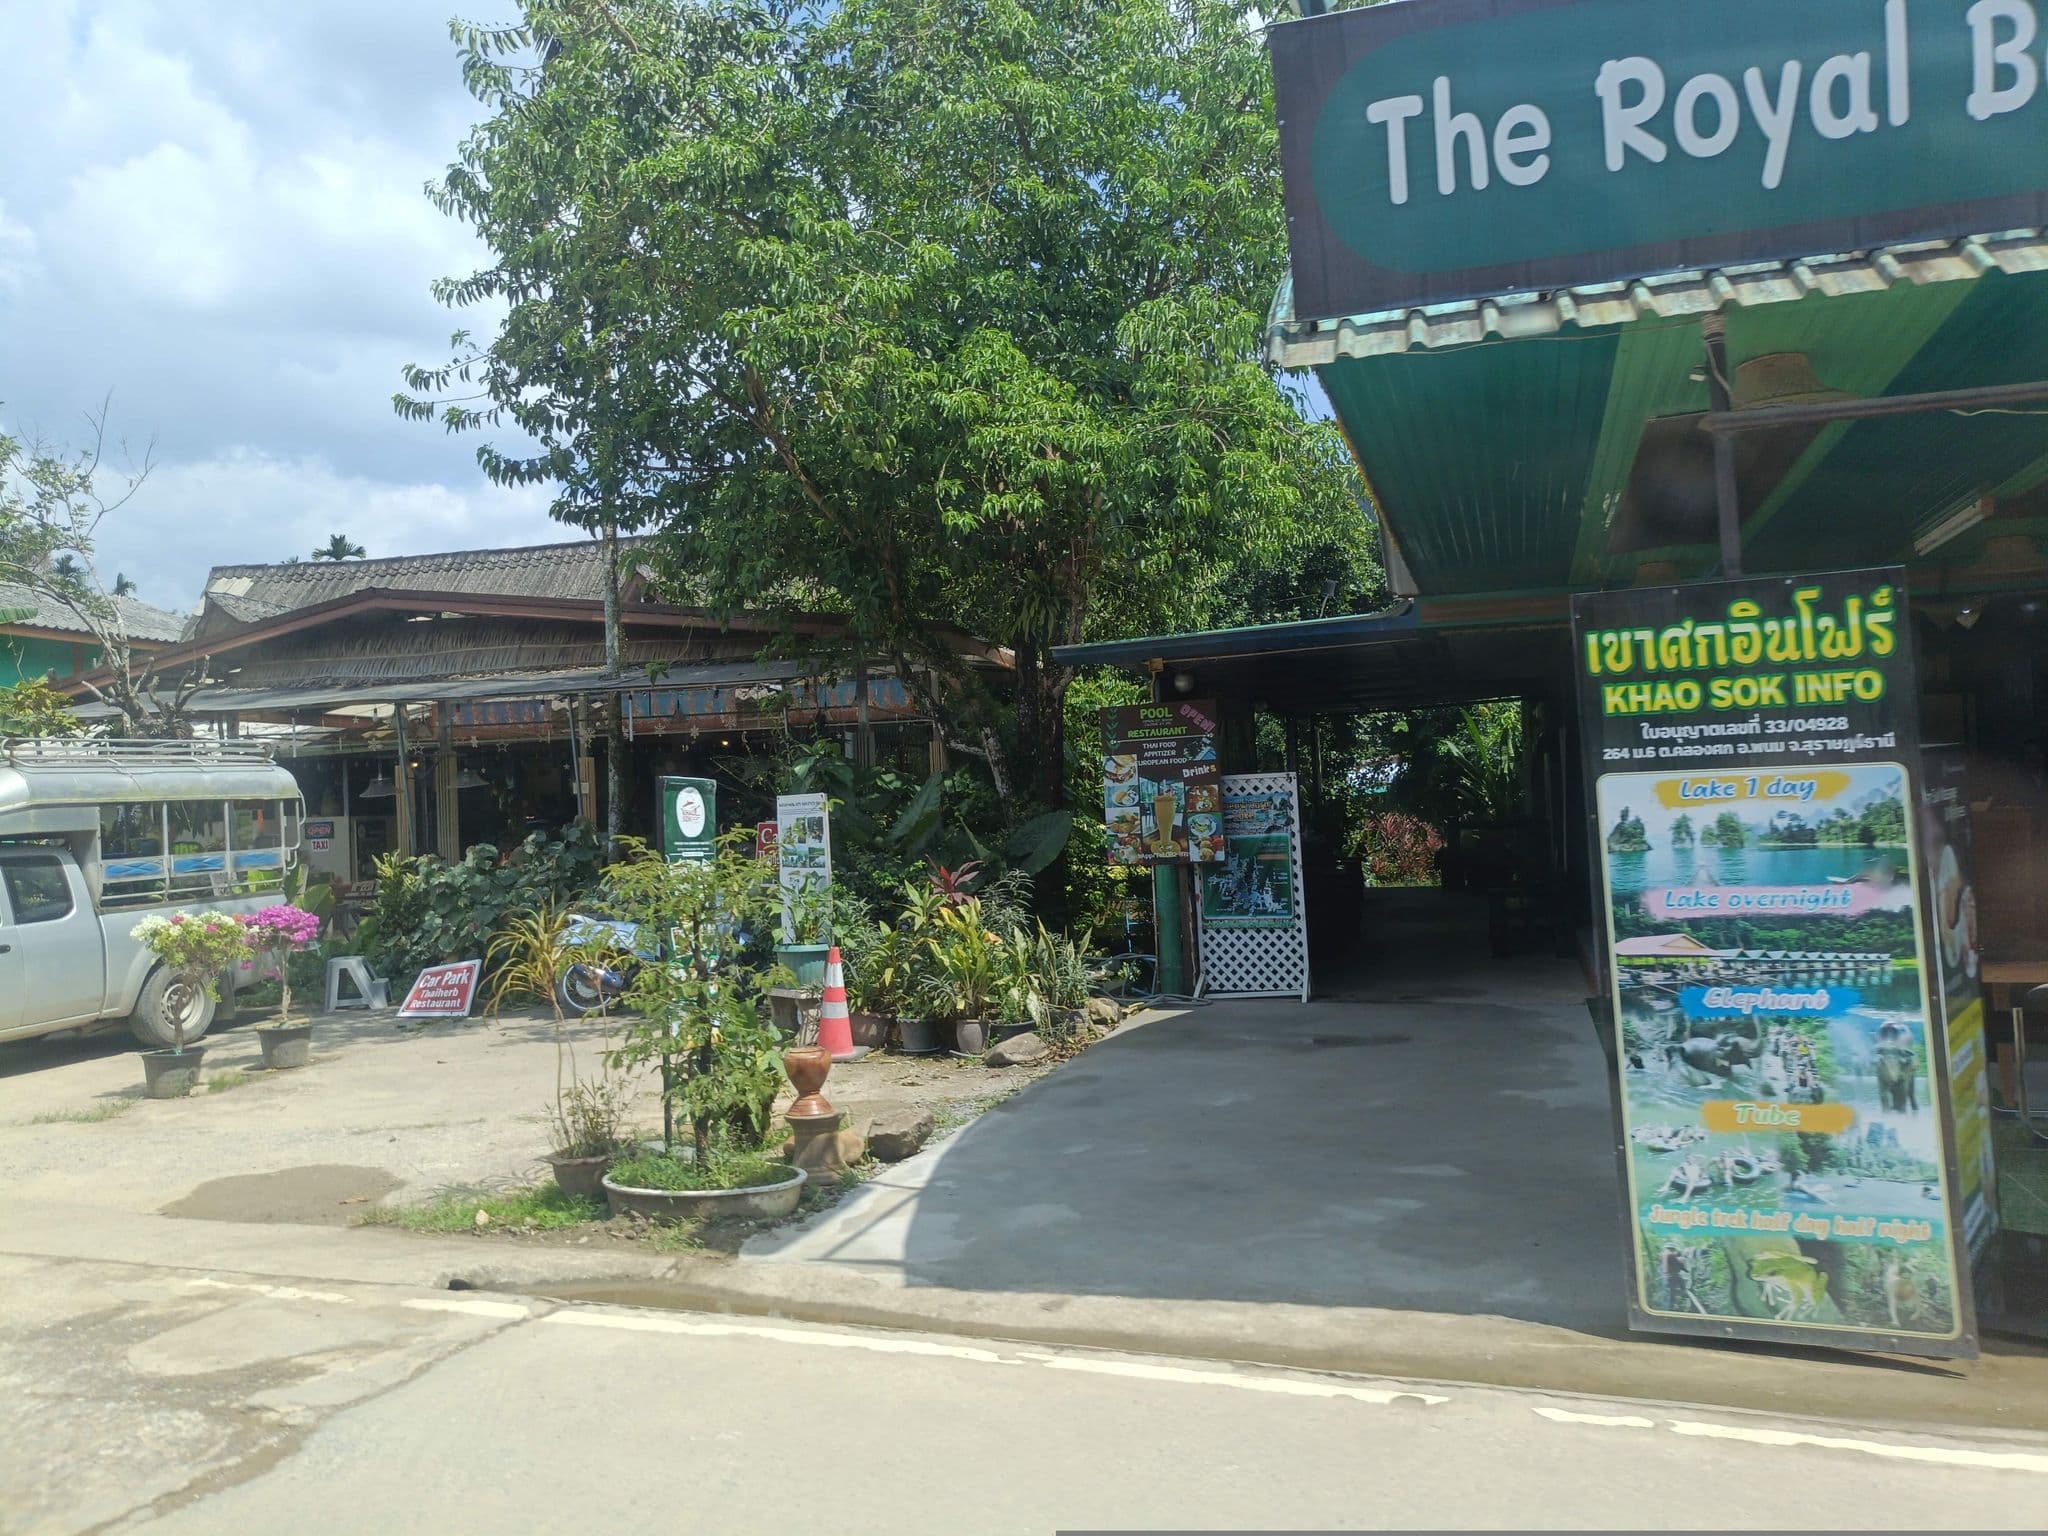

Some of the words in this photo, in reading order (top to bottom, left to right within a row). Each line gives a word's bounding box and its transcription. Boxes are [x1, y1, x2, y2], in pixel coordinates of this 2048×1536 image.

[1366, 75, 1551, 205] The
[1595, 0, 1910, 190] Royal
[1966, 0, 2048, 120] B
[1585, 585, 1894, 675] เขาศกอินโฟร์
[1603, 680, 1701, 714] KHAO
[1710, 673, 1786, 708] SOK
[1793, 669, 1884, 704] INFO
[1140, 707, 1173, 719] POOL
[1128, 726, 1188, 738] RESTAURANT
[1763, 716, 1849, 733] 33/04928
[1603, 747, 1631, 760] 264
[1182, 764, 1217, 778] Drinks
[1680, 780, 1736, 798] Lake
[1745, 777, 1761, 796] 1
[1767, 778, 1816, 801] day
[312, 840, 329, 850] TAXI
[1665, 890, 1719, 909] Lake
[1727, 888, 1852, 912] overnight
[419, 974, 442, 988] Car
[441, 969, 470, 986] Park
[420, 987, 459, 998] Thaiherb
[1703, 987, 1830, 1014] Elephant
[409, 998, 461, 1008] Restaurant
[1734, 1103, 1801, 1126] Tube
[1650, 1204, 1709, 1230] Jungle
